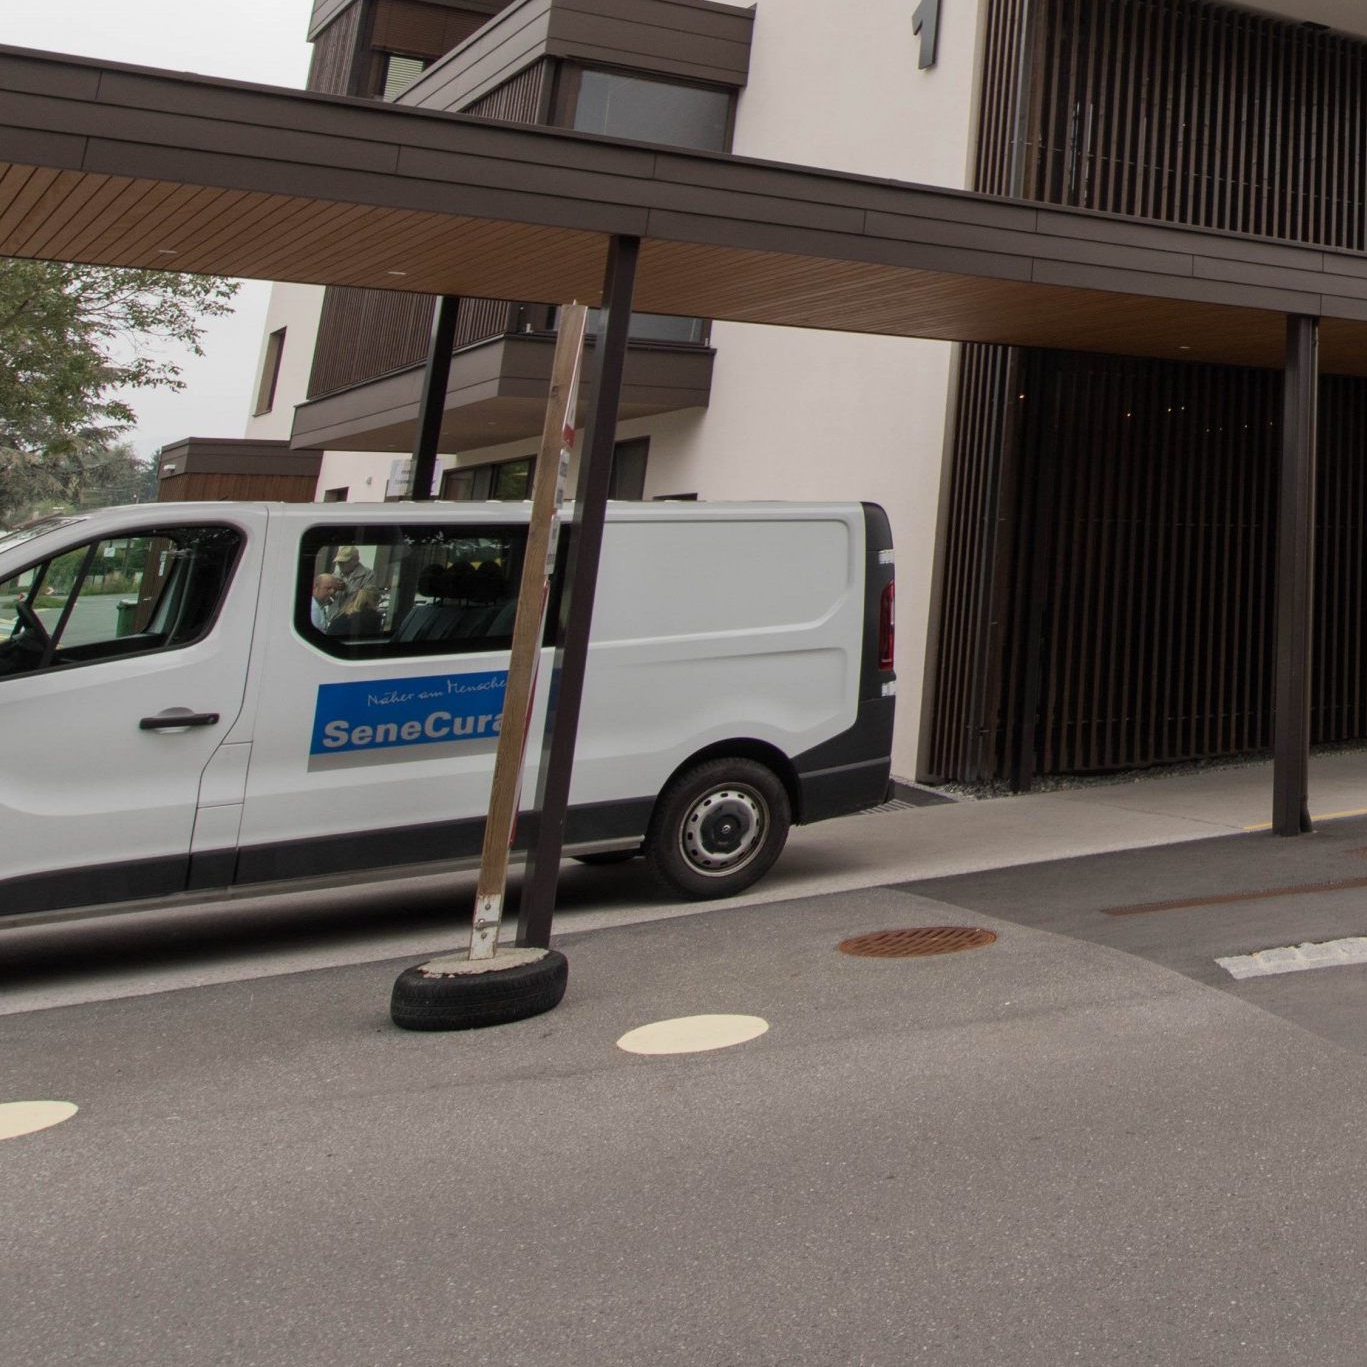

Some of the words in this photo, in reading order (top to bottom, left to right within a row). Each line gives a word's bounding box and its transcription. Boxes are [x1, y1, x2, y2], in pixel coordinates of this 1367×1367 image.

[368, 690, 415, 707] Näher
[416, 690, 444, 700] am
[446, 676, 508, 695] Mensche
